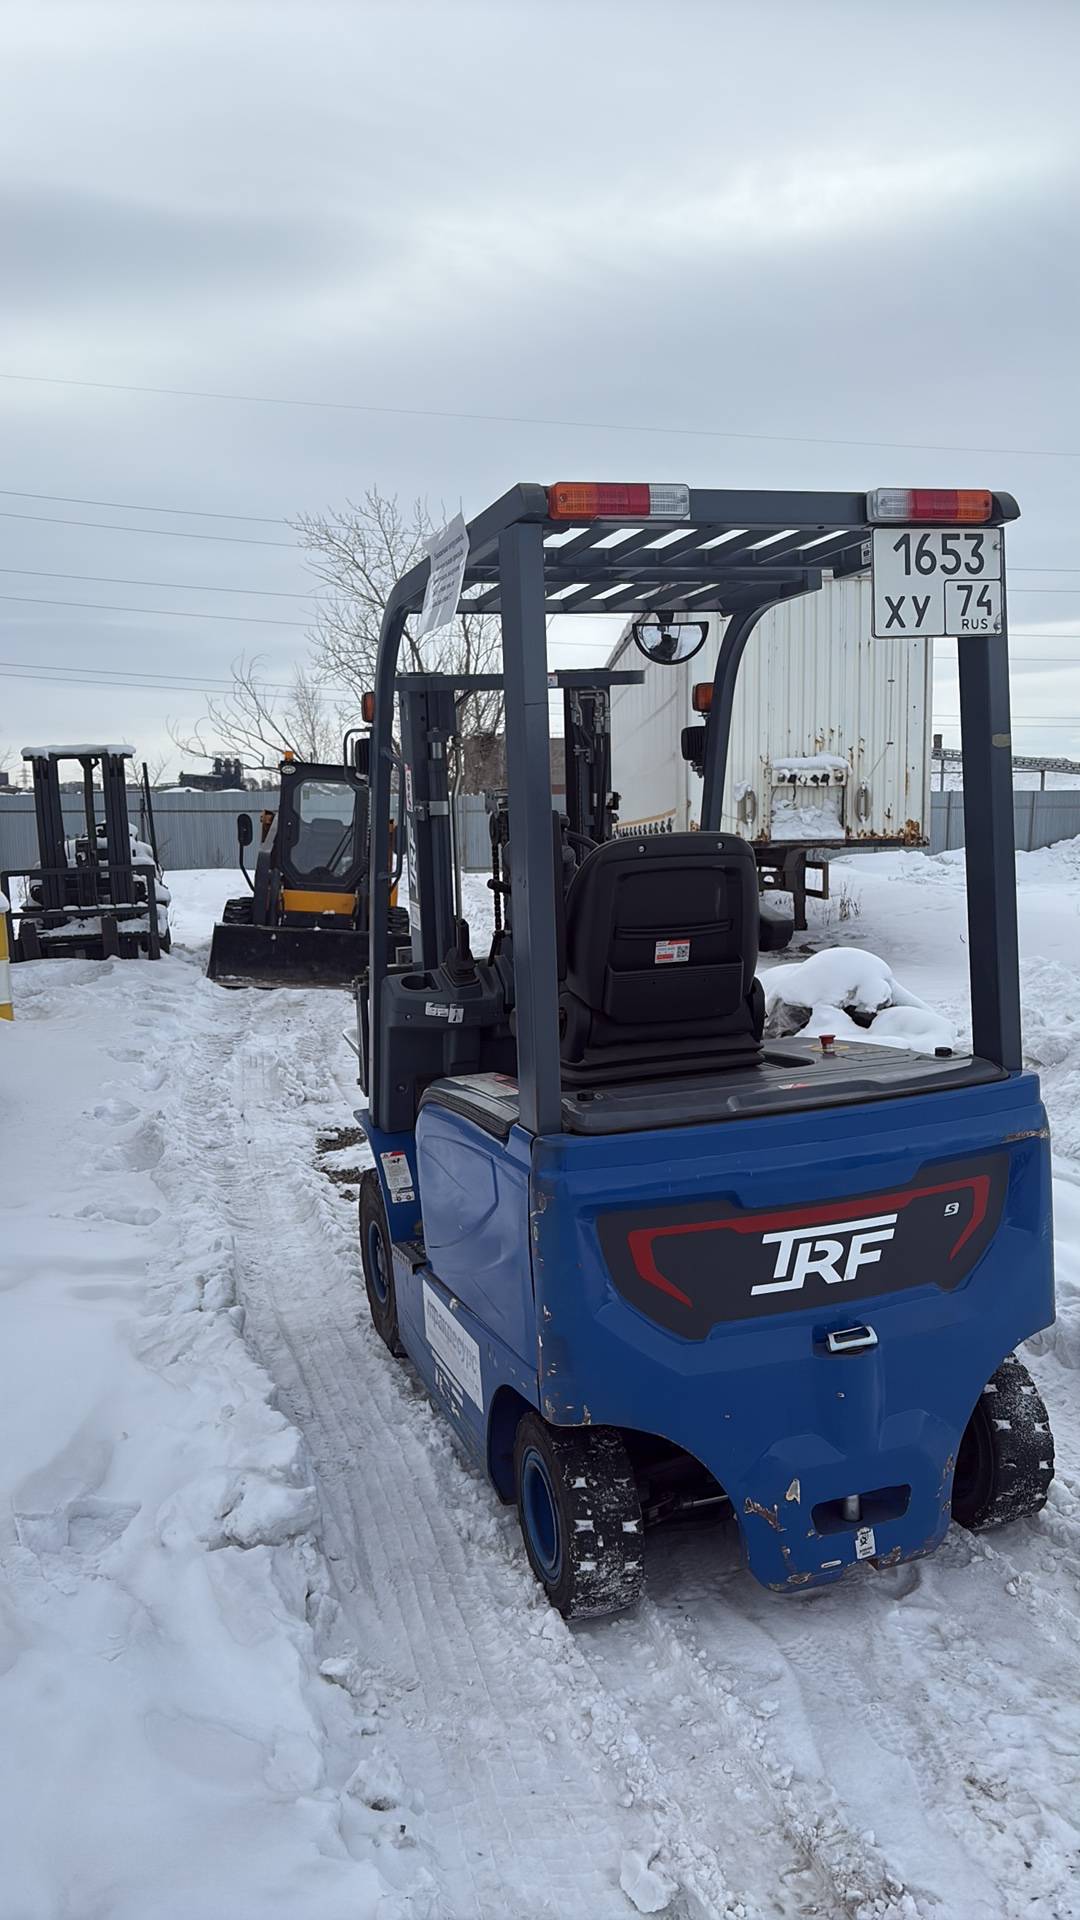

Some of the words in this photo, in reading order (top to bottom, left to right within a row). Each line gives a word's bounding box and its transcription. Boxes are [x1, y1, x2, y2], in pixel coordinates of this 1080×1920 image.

[893, 533, 985, 576] 1653
[956, 584, 992, 617] 74
[961, 618, 989, 630] RUS
[750, 1213, 898, 1296] TRF
